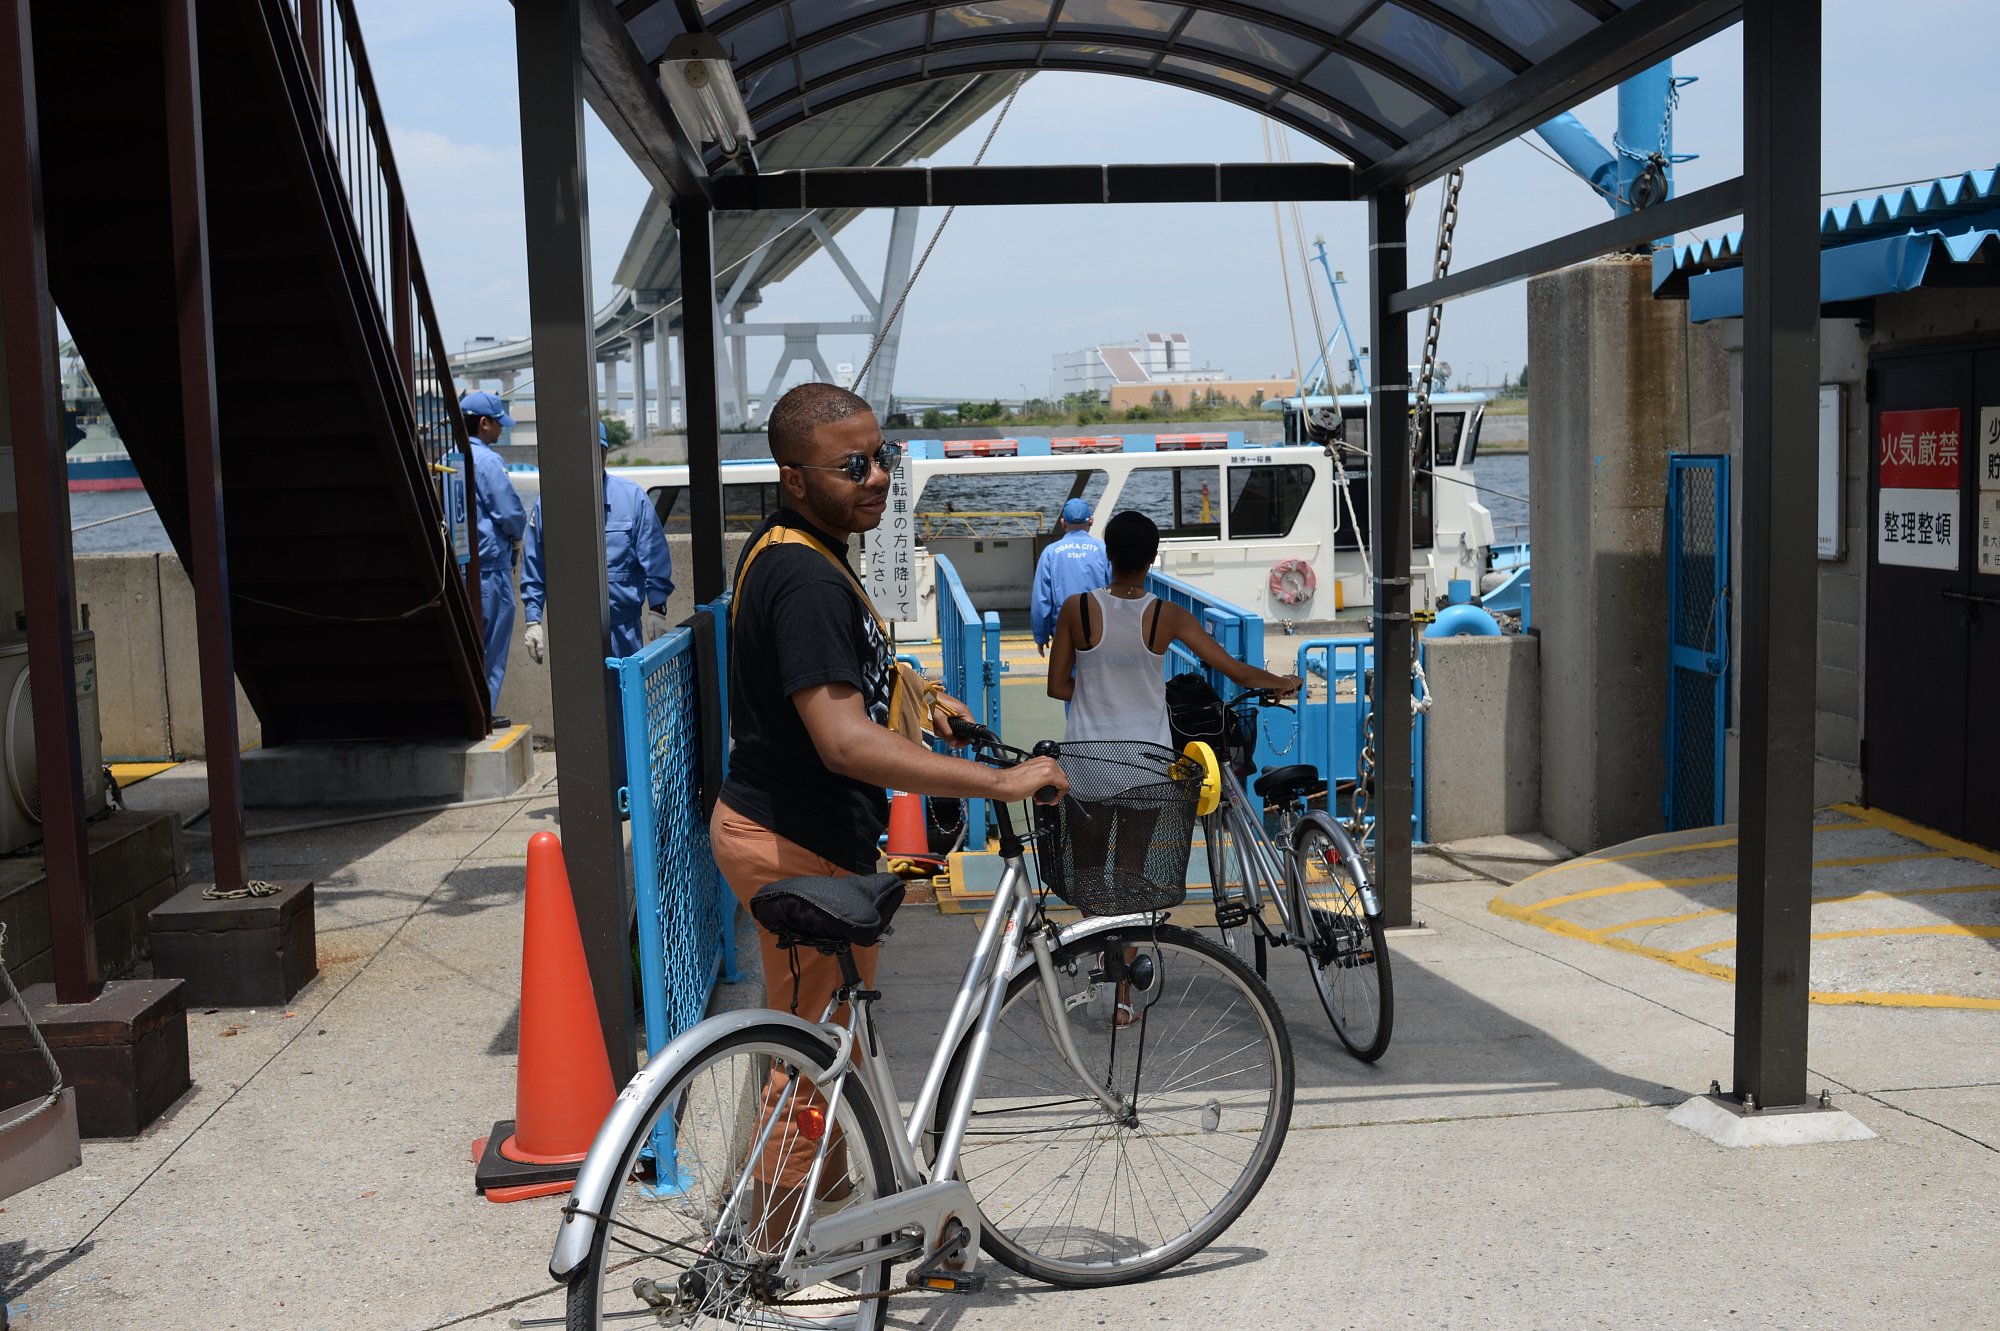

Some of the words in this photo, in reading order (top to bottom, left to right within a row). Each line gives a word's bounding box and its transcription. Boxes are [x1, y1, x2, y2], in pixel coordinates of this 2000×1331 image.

[1881, 431, 1958, 466] 火気厳禁
[892, 466, 910, 615] 自転車の方は降りて
[1884, 511, 1952, 545] 整理整頓
[872, 518, 887, 598] ください
[1054, 543, 1080, 553] OSAKA
[1081, 543, 1098, 552] CITY
[73, 652, 93, 665] OSHIBA
